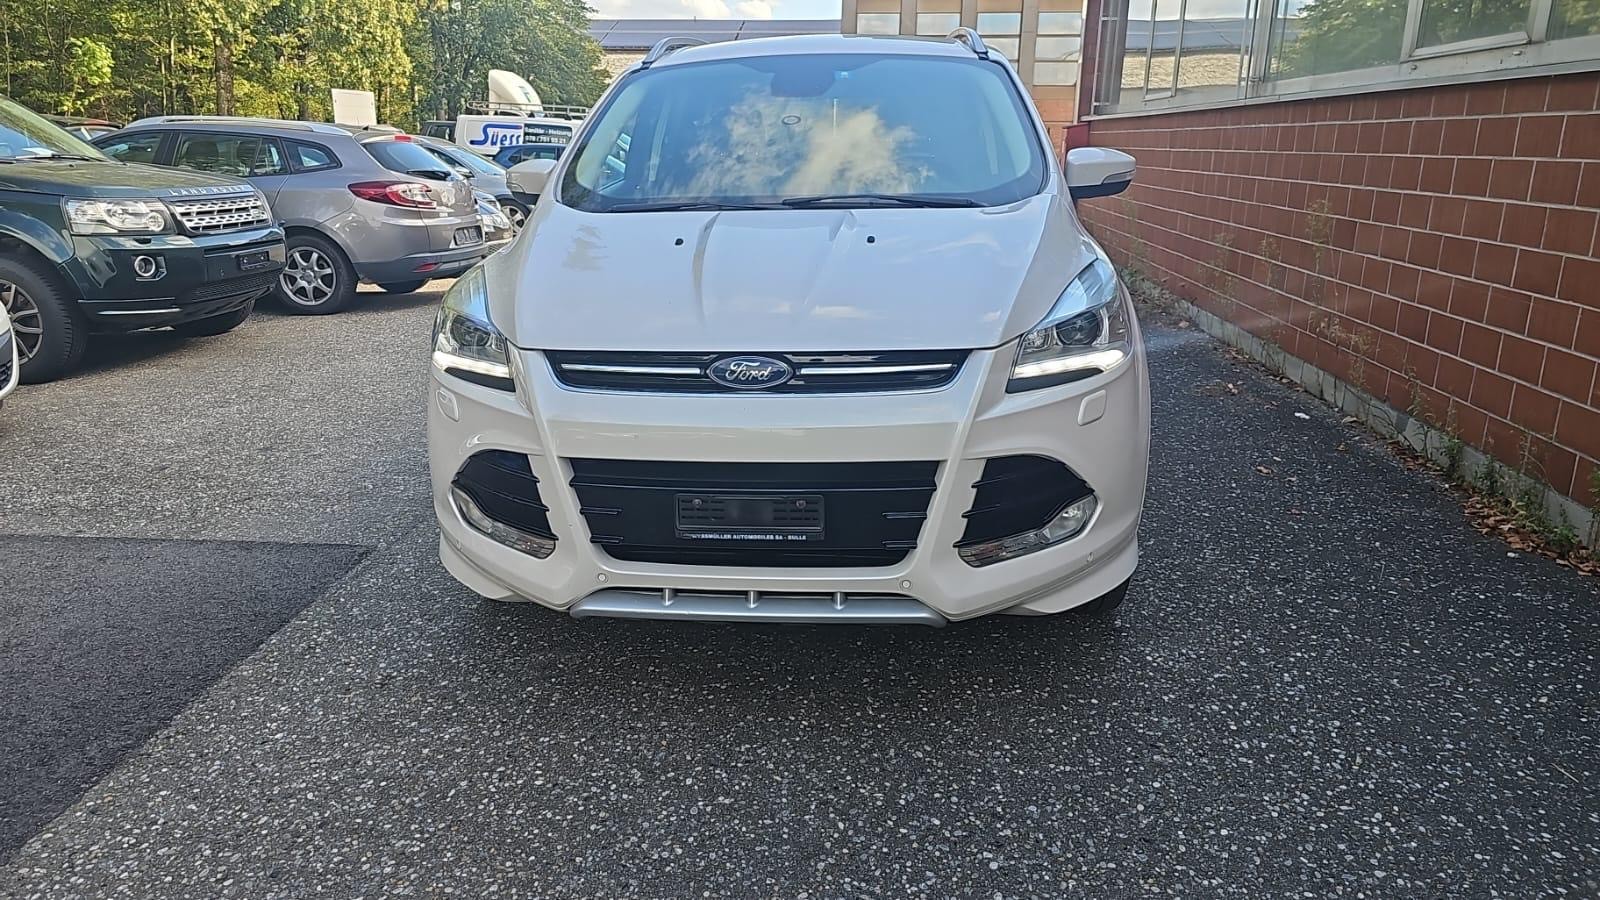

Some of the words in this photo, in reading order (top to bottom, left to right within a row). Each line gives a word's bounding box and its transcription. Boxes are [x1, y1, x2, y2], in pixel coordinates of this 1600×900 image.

[470, 123, 523, 146] Süess
[168, 187, 206, 196] LAND
[725, 361, 772, 380] Ford
